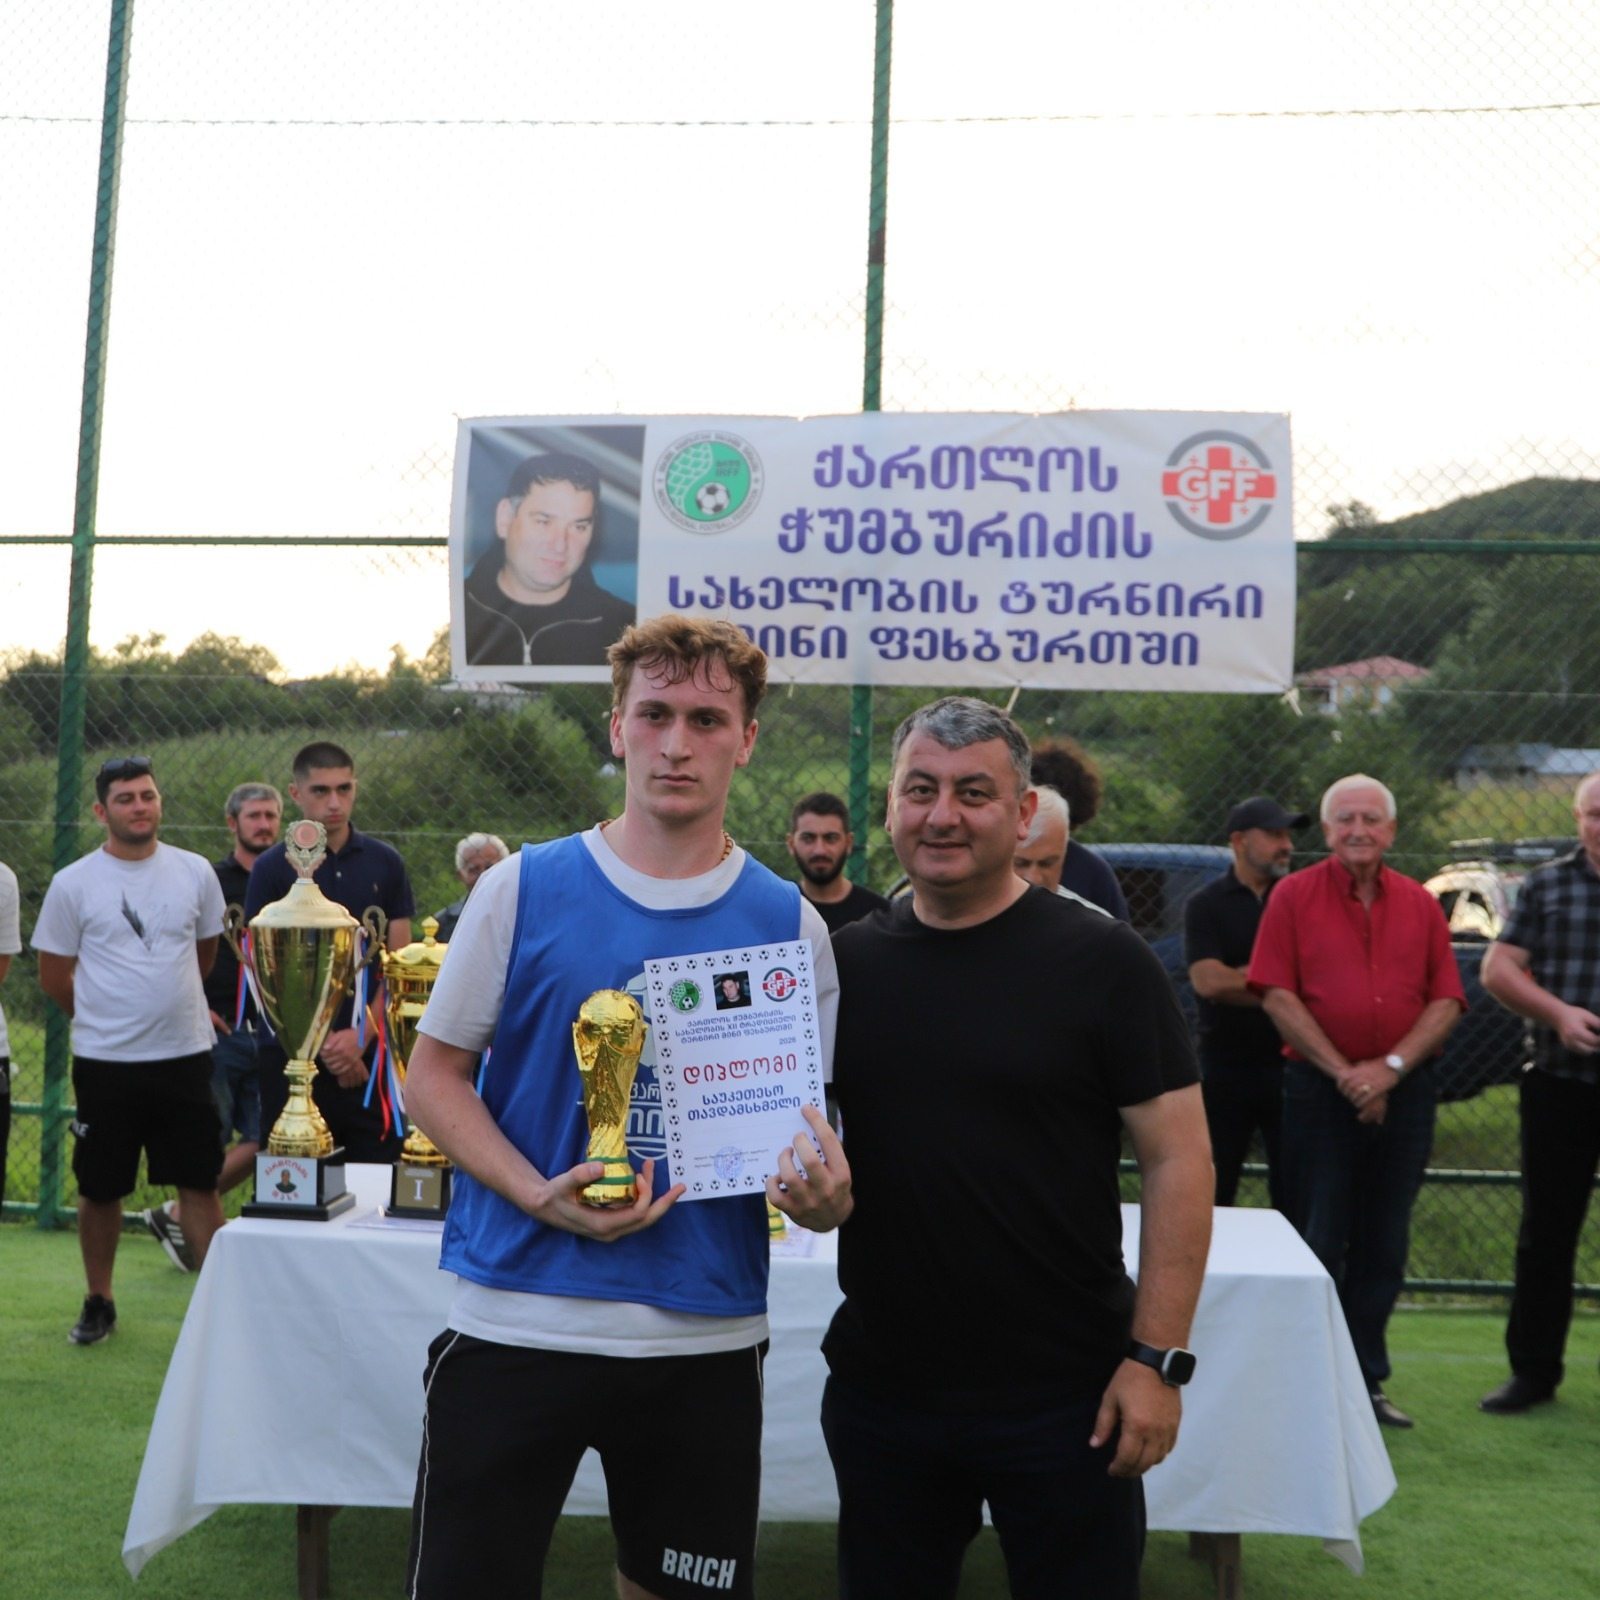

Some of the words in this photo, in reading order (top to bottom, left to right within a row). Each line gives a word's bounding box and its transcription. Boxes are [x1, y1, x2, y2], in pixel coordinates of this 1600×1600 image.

[813, 444, 1118, 492] ქართლოს
[1178, 468, 1258, 502] GFF
[777, 506, 1152, 559] ჭუმბურიძის
[668, 575, 978, 614] სახელობის
[1000, 581, 1263, 618] ტურნირი
[738, 623, 847, 659] ინი
[869, 626, 1199, 666] ფეხბურთში
[767, 978, 791, 990] GFF
[727, 1022, 738, 1031] XII
[683, 1053, 797, 1085] დიპლომი
[687, 1096, 801, 1121] თავდამსხმელი
[702, 1084, 784, 1106] საუკეთესო
[662, 1547, 736, 1589] BRICH
